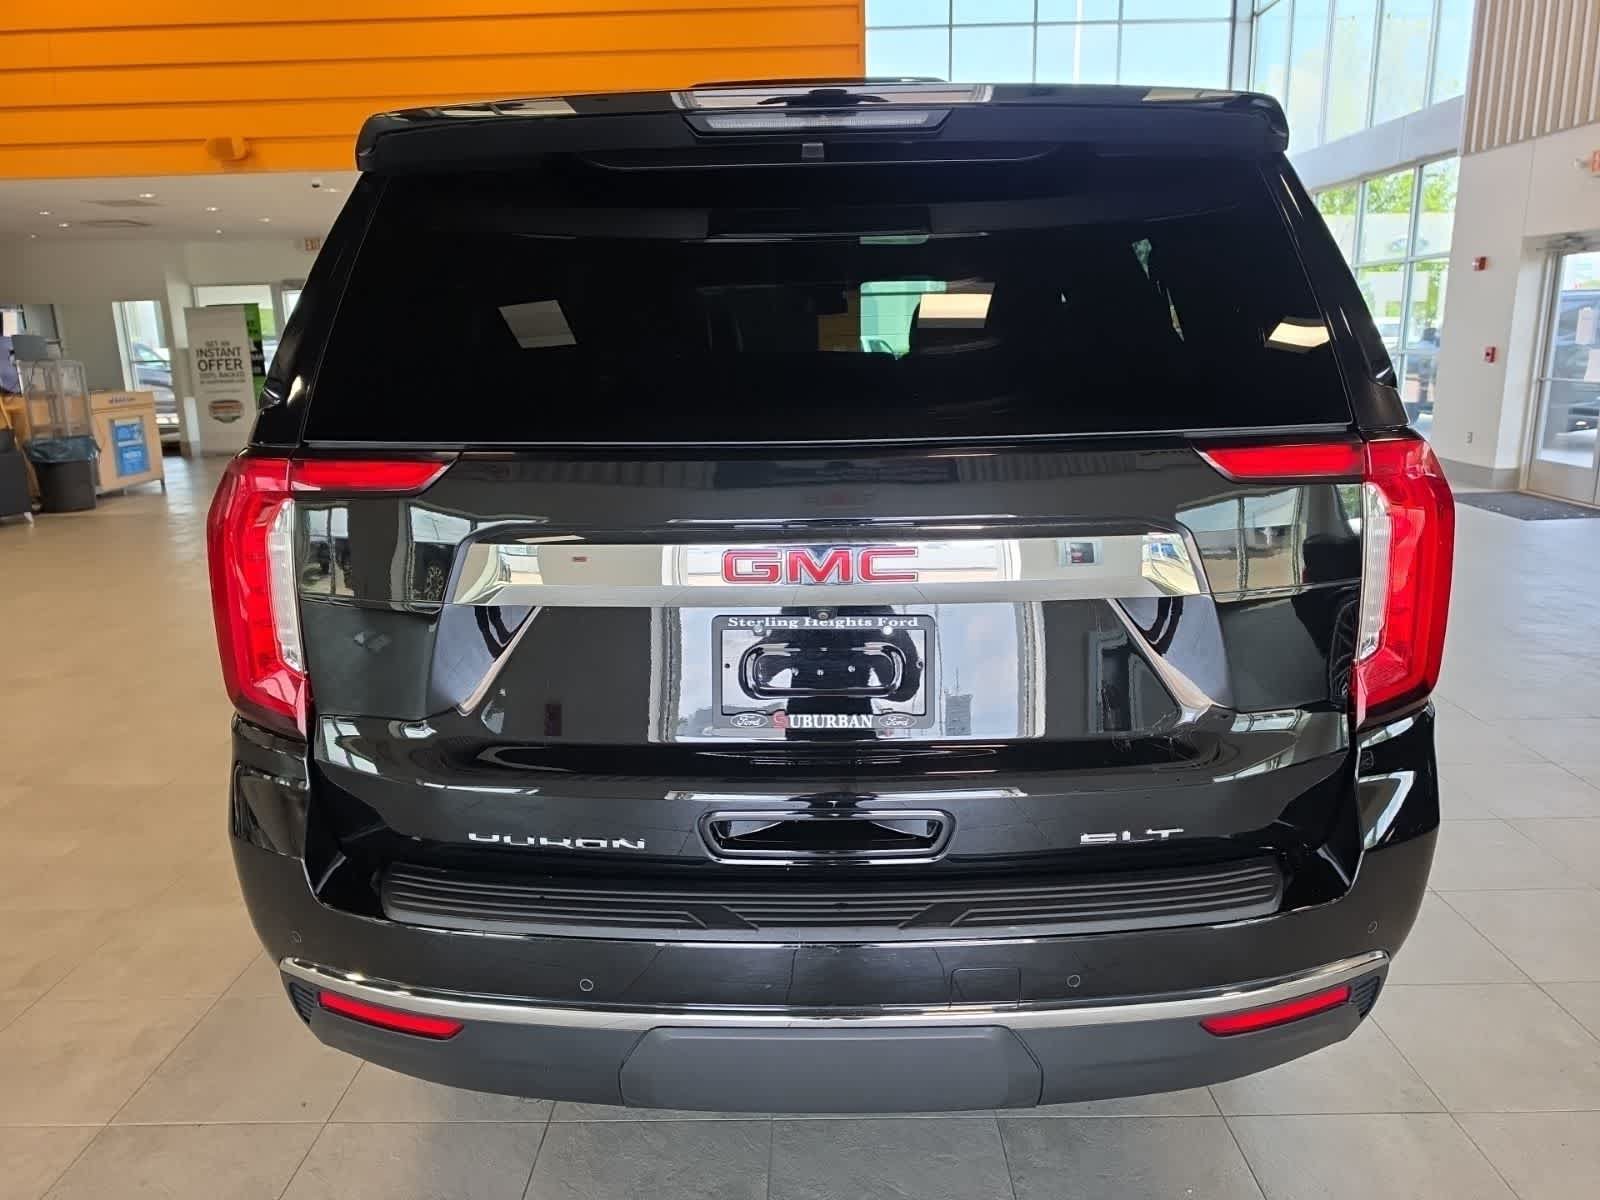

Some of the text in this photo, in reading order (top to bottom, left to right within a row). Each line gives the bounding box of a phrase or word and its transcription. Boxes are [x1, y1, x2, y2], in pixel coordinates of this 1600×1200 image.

[196, 347, 241, 358] INSTANT
[198, 358, 244, 372] OFFER
[721, 546, 919, 585] GMC
[727, 617, 919, 629] Sterling Heights Ford
[736, 715, 762, 727] Ford
[773, 711, 874, 729] SUBURBAN
[885, 715, 909, 727] Ford
[1080, 829, 1184, 844] SLT
